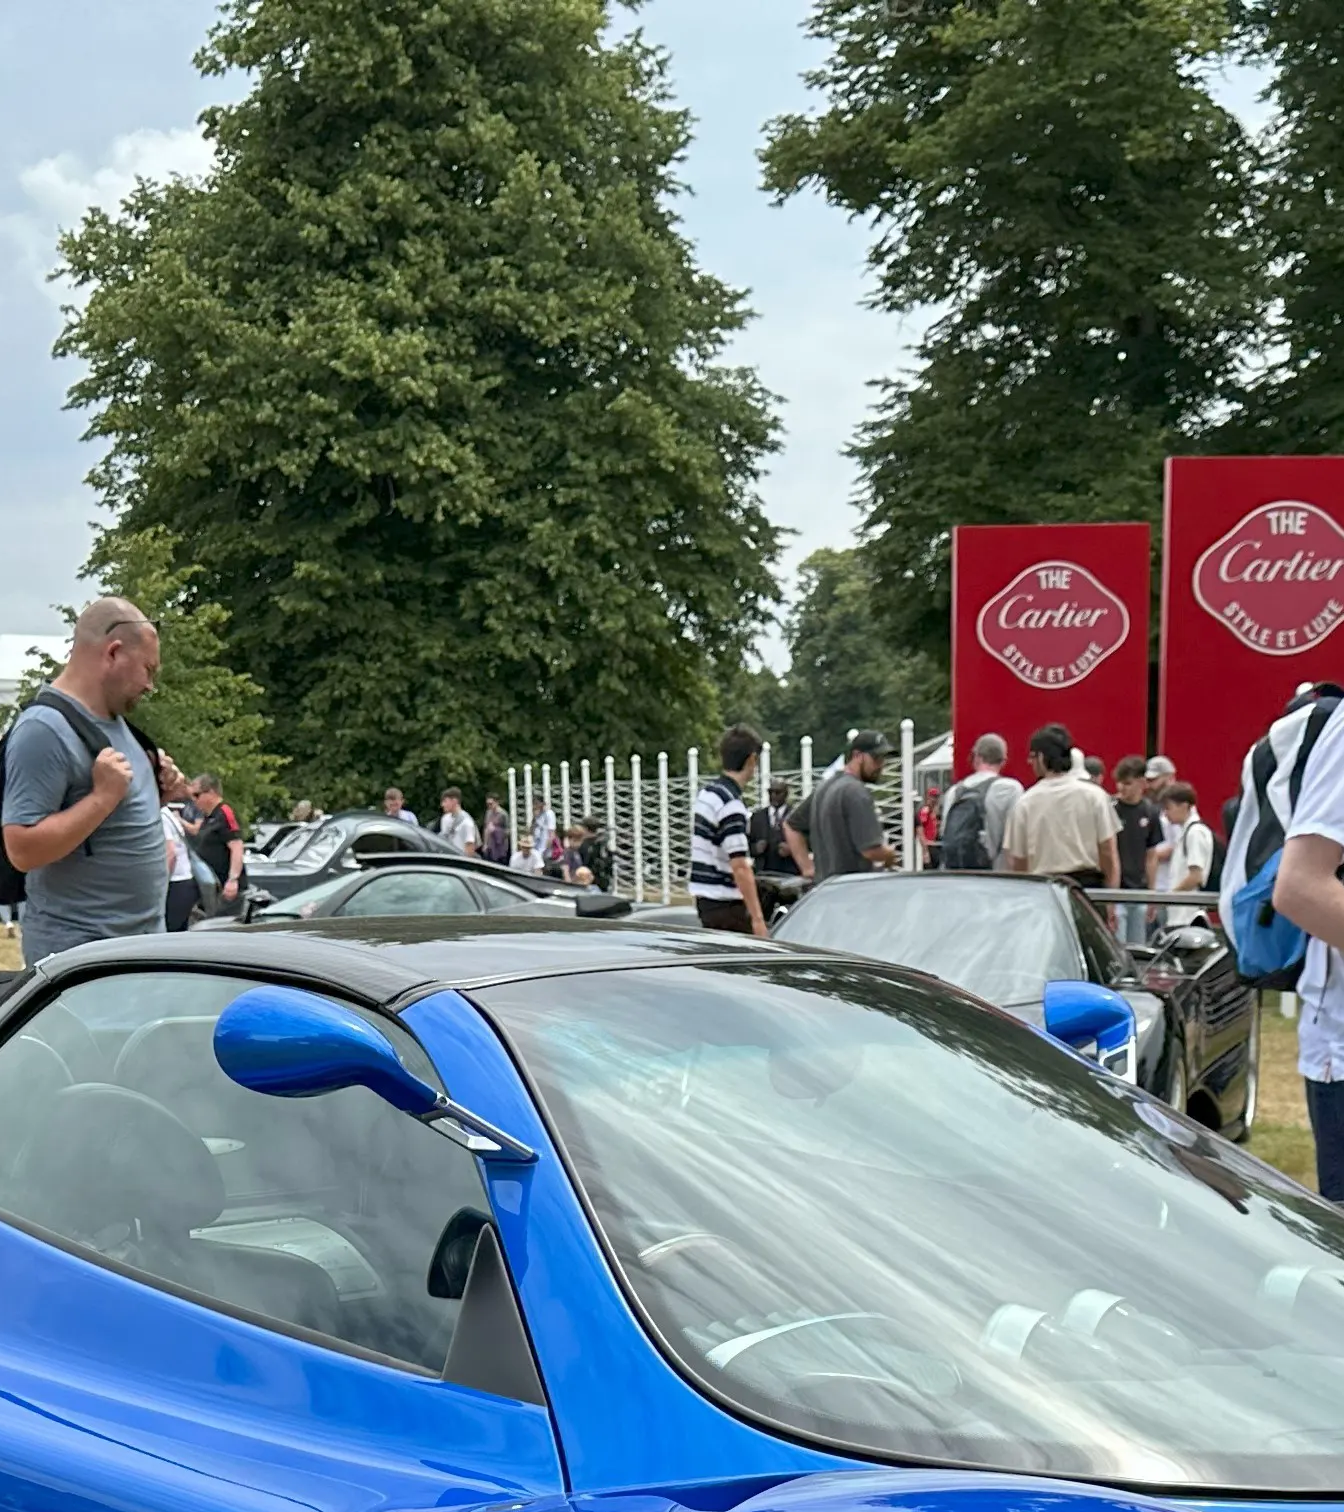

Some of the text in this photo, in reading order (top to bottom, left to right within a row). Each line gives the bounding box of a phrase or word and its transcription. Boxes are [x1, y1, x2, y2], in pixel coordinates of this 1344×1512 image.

[1266, 511, 1309, 535] THE
[1036, 569, 1072, 590] THE
[998, 594, 1109, 629] Cartier
[1223, 597, 1344, 648] STYLE ET LUXE
[1002, 640, 1104, 683] STYLE ET LUXE
